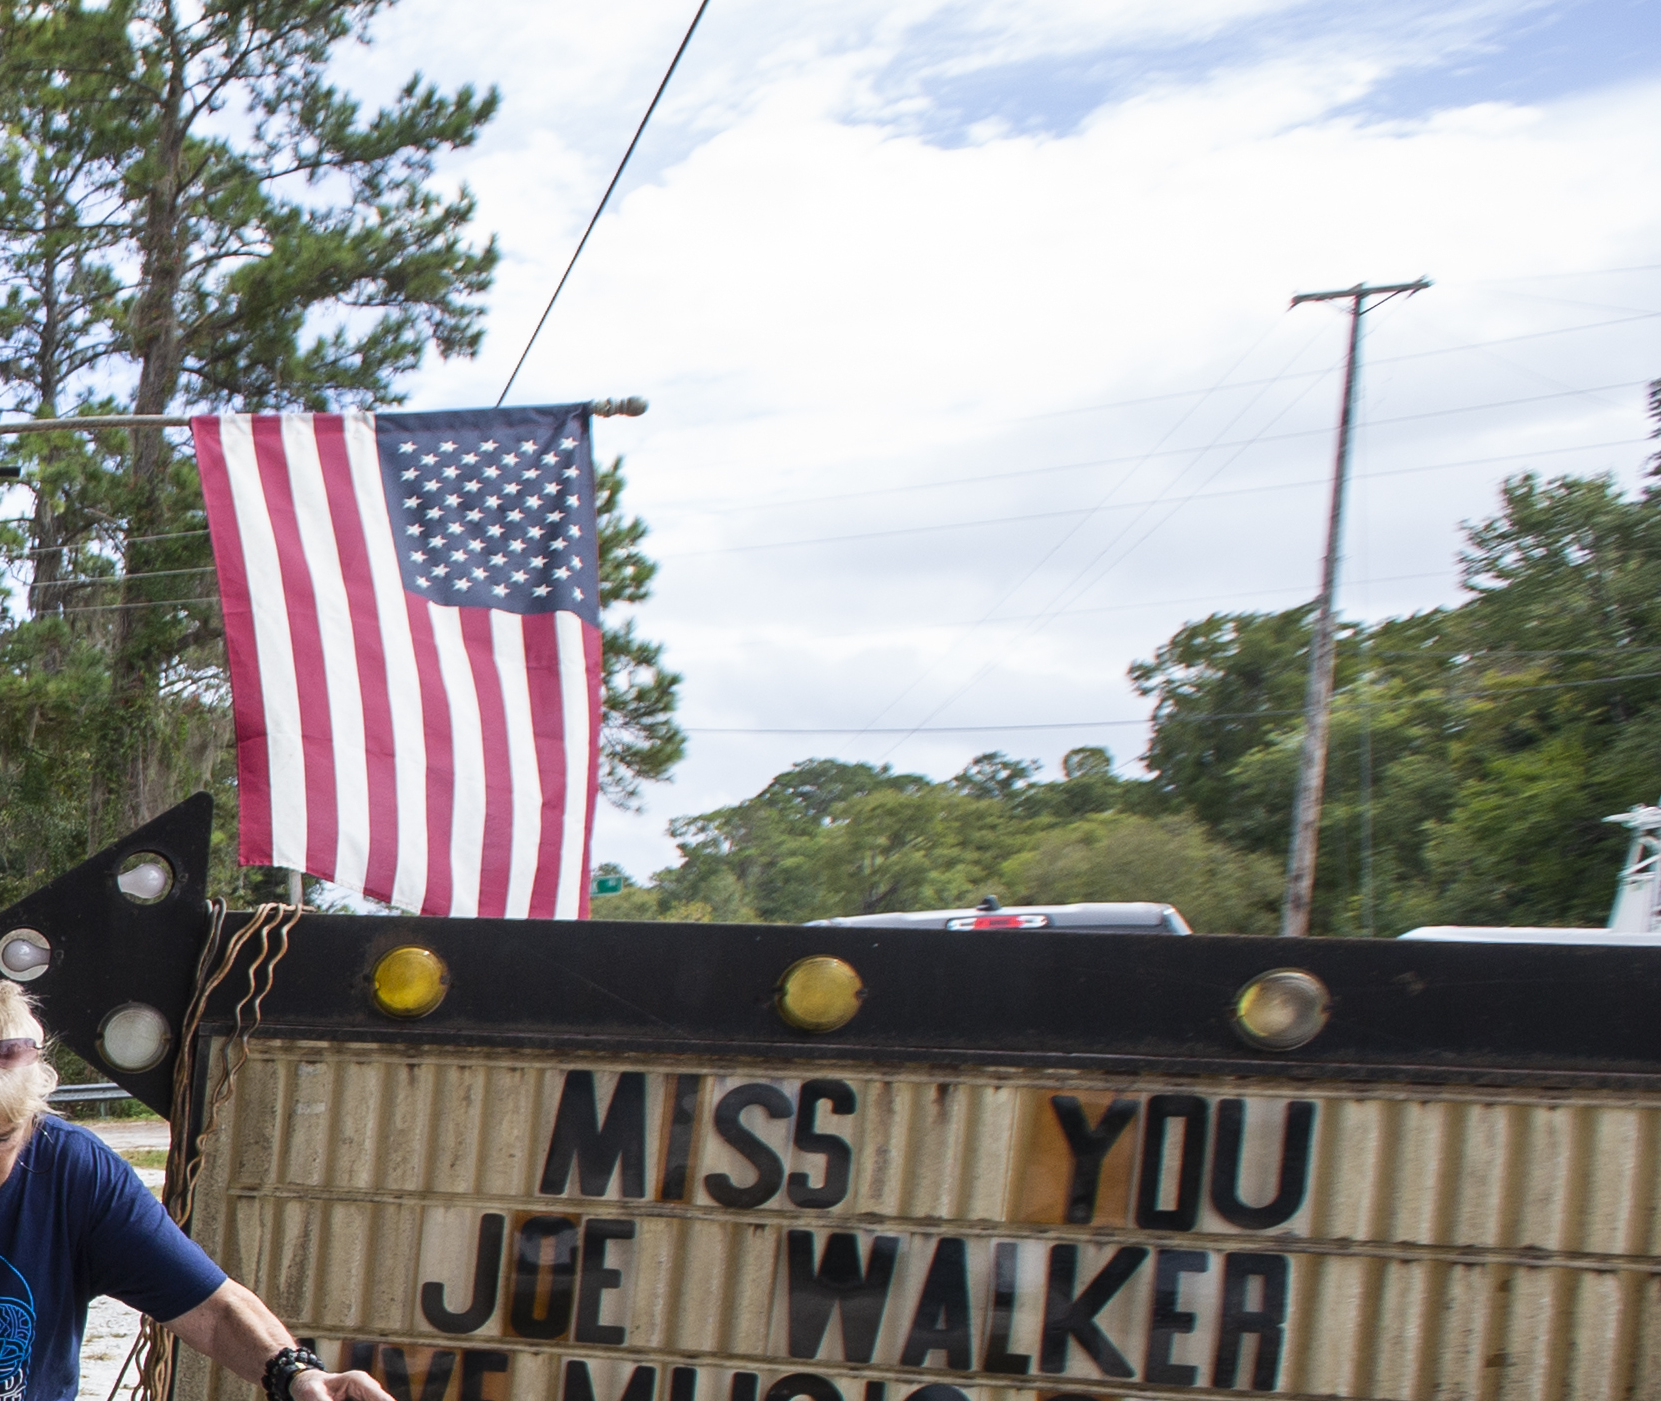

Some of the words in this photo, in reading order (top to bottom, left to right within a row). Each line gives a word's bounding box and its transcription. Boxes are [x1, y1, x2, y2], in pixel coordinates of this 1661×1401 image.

[539, 1070, 856, 1210] MISS
[1050, 1092, 1317, 1232] YOU
[419, 1213, 637, 1346] JOE
[786, 1229, 1290, 1392] WALKER
